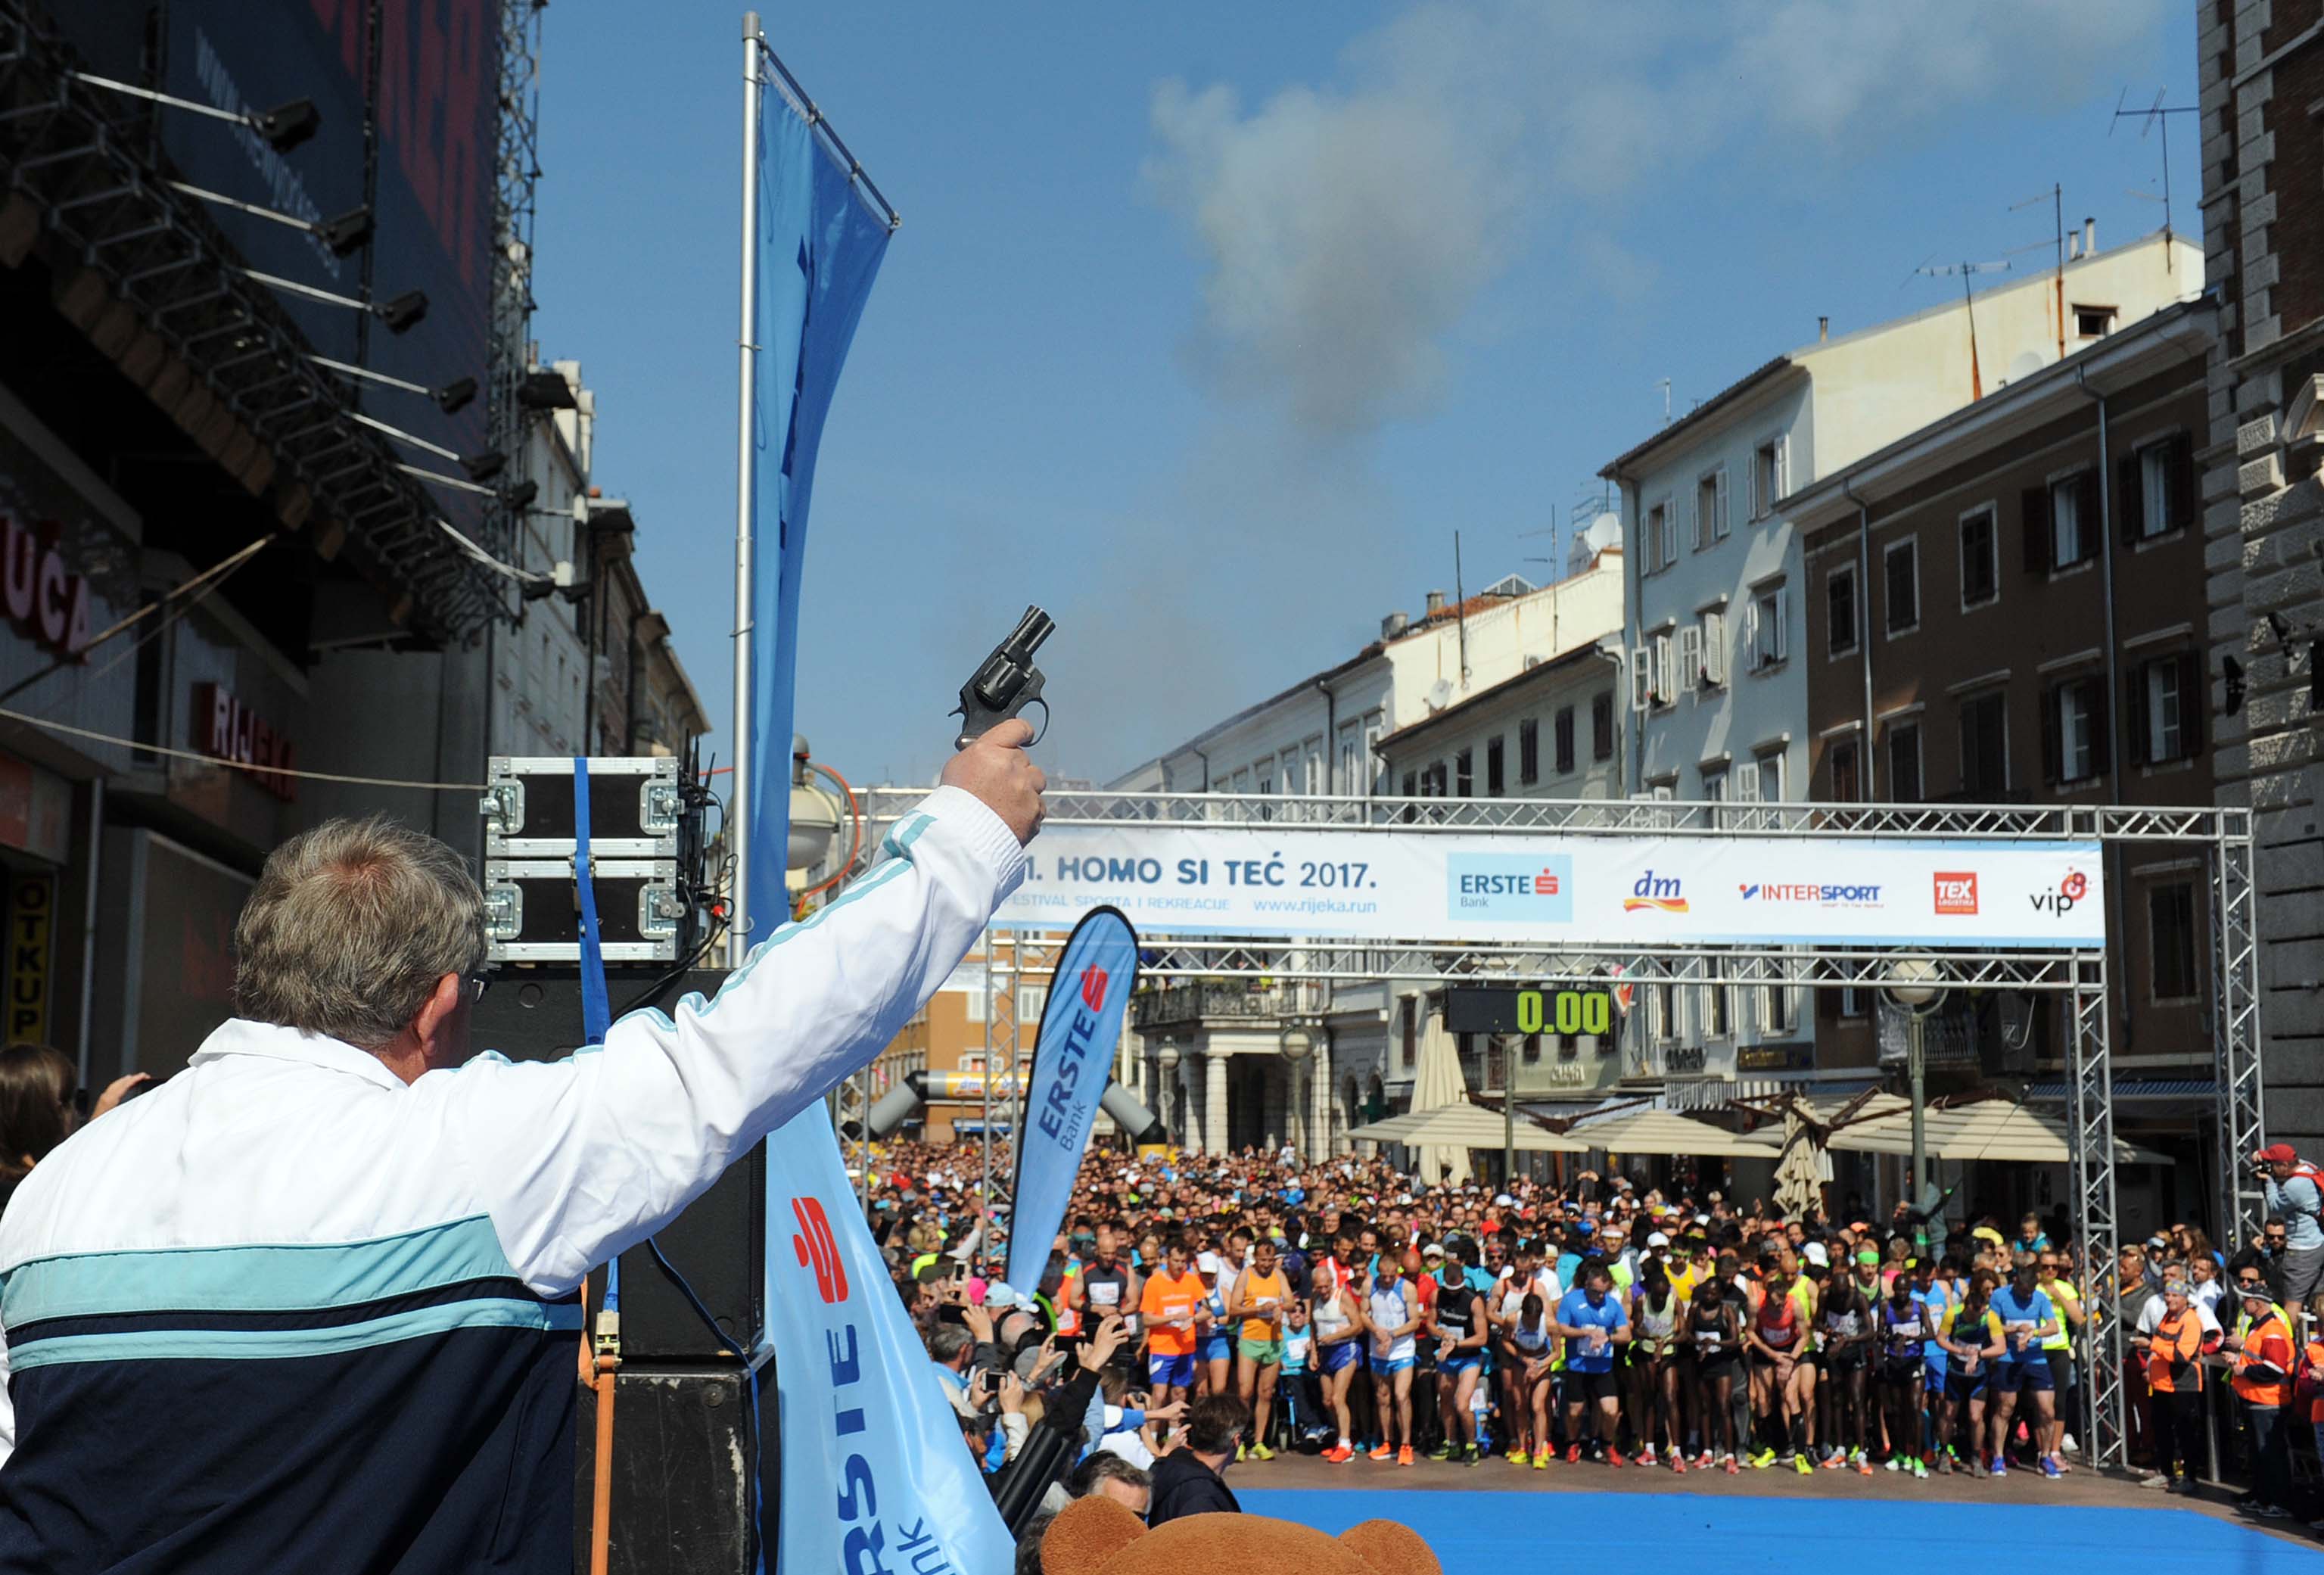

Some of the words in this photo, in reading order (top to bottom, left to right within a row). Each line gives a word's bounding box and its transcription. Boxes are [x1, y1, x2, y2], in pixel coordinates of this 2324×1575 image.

[1058, 856, 1162, 884] HOMO
[1177, 859, 1209, 886] SI
[1224, 851, 1285, 886] TEĆ
[1299, 862, 1377, 889] 2017.
[1634, 870, 1681, 898] dm
[1461, 875, 1530, 895] ERSTE
[1762, 884, 1881, 901] INTERSPORT
[1937, 879, 1972, 898] TEX
[1075, 895, 1131, 908] SPORTA
[1137, 896, 1141, 909] I
[1147, 898, 1230, 910] REKREACIJE
[1254, 896, 1377, 914] www.rijeka.run
[1461, 897, 1489, 907] Bank
[2030, 887, 2073, 917] vip
[14, 882, 46, 1035] OTKUP
[1517, 991, 1609, 1035] 0.00
[1038, 1008, 1096, 1140] ERSTE
[1059, 1100, 1087, 1152] Bank
[897, 1516, 956, 1575] nk
